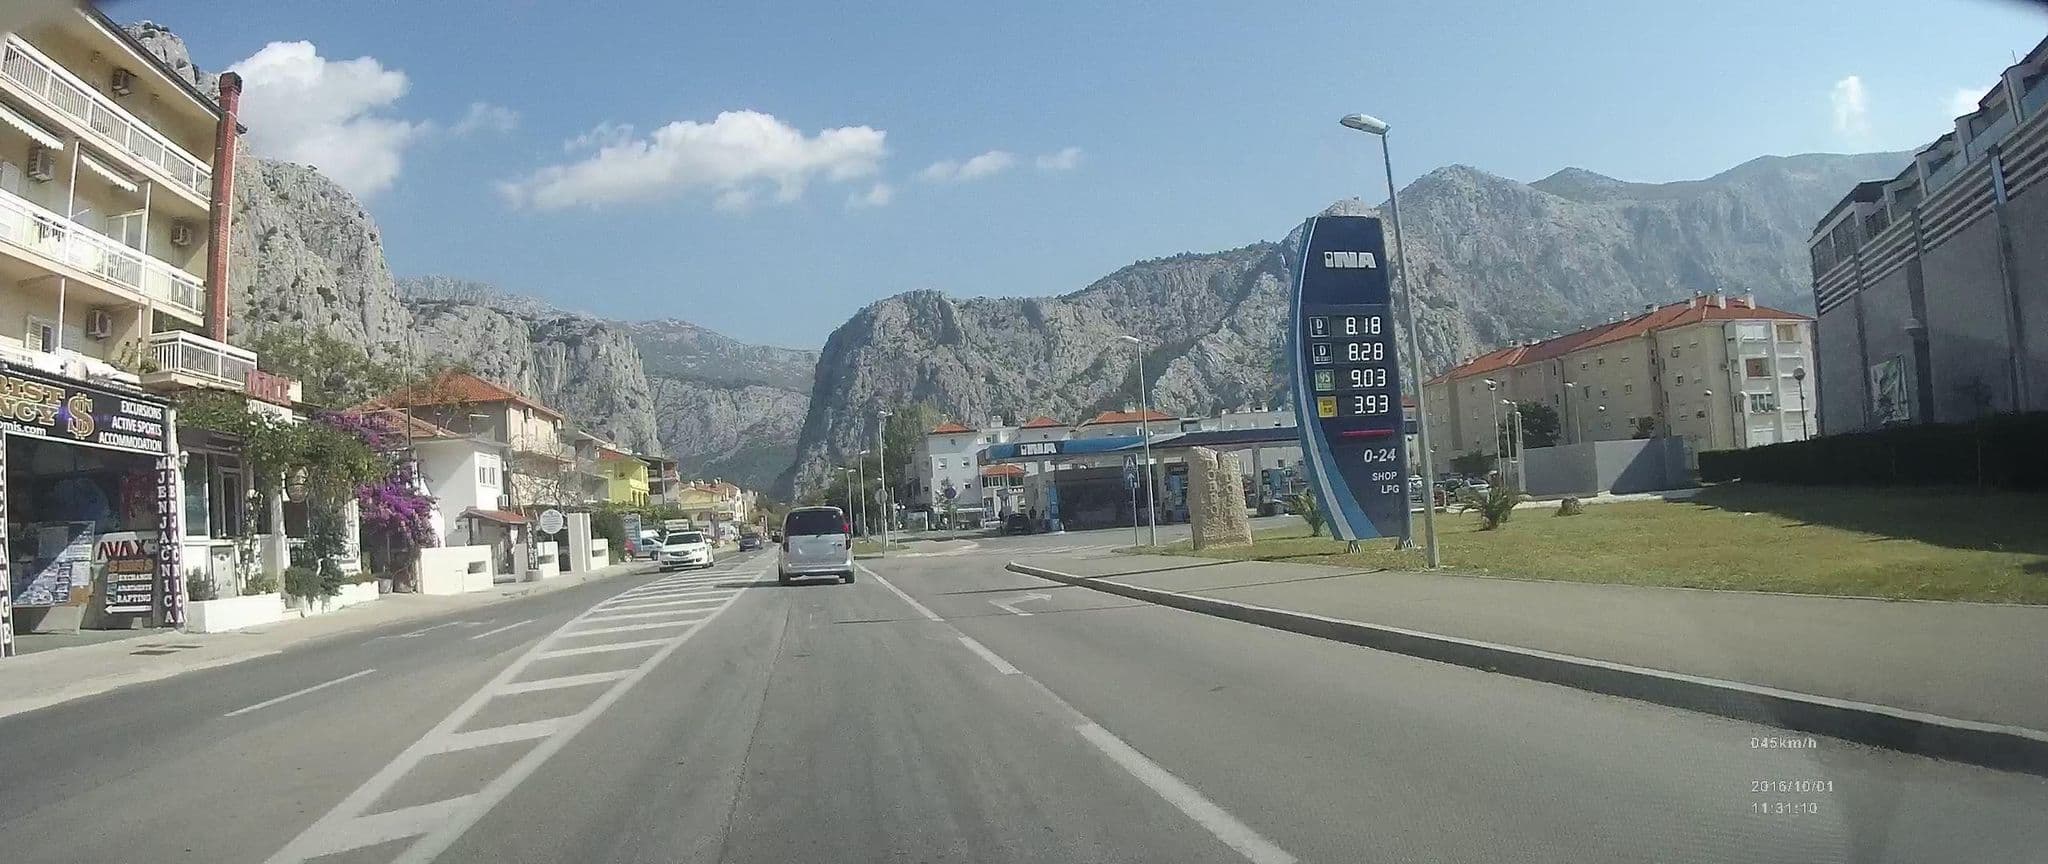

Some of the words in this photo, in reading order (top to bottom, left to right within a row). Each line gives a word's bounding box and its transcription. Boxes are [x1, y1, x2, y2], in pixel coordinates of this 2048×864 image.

[1346, 317, 1381, 335] 8.18
[1349, 343, 1383, 361] 8.28
[1352, 369, 1386, 388] 9.03
[121, 400, 162, 419] EXCURSIONS
[1355, 394, 1389, 414] 3.93
[111, 415, 139, 432] ACTIVE
[138, 419, 162, 436] SPORTS
[99, 431, 162, 452] ACCOMMODATION
[1364, 448, 1396, 462] 0-24
[1372, 471, 1398, 481] SHOP
[1381, 484, 1400, 494] LPG
